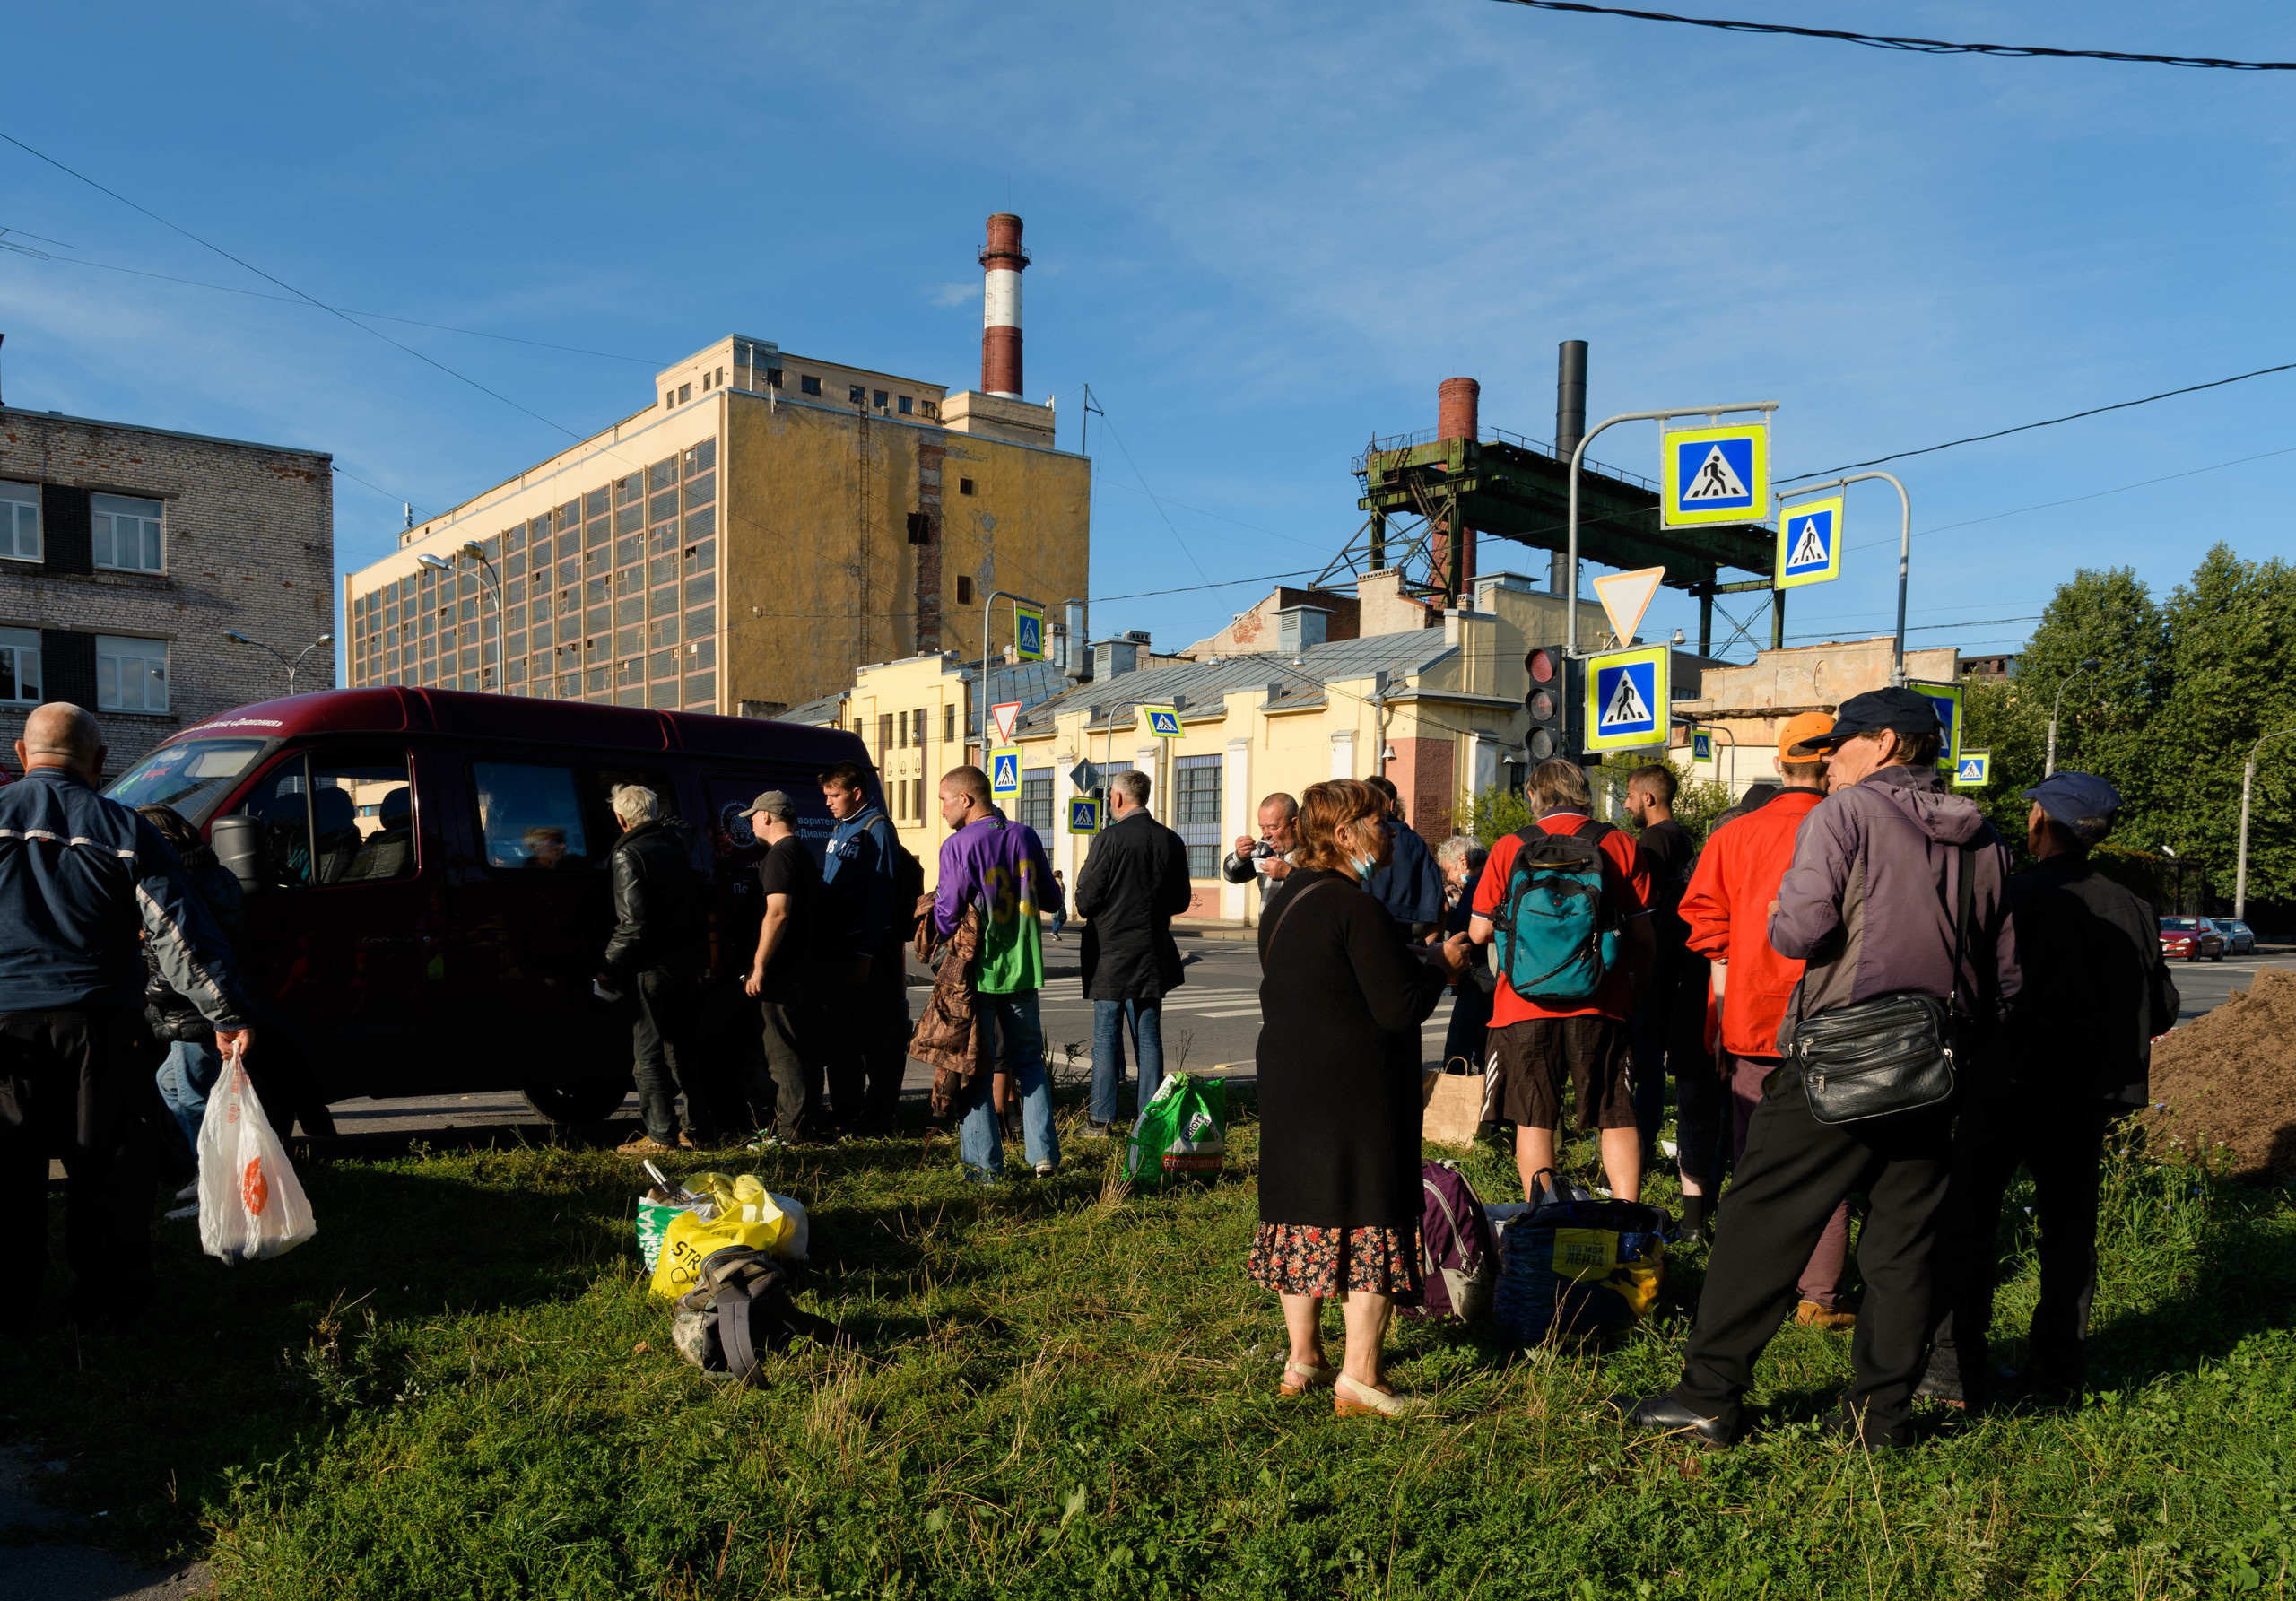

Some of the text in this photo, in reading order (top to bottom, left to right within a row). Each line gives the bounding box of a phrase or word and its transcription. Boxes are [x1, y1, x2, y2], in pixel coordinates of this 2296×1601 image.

[983, 858, 1039, 925] 33
[1182, 1118, 1201, 1141] LEROY
[637, 1208, 660, 1273] RISMA
[1565, 1252, 1604, 1267] ЛЕНТА
